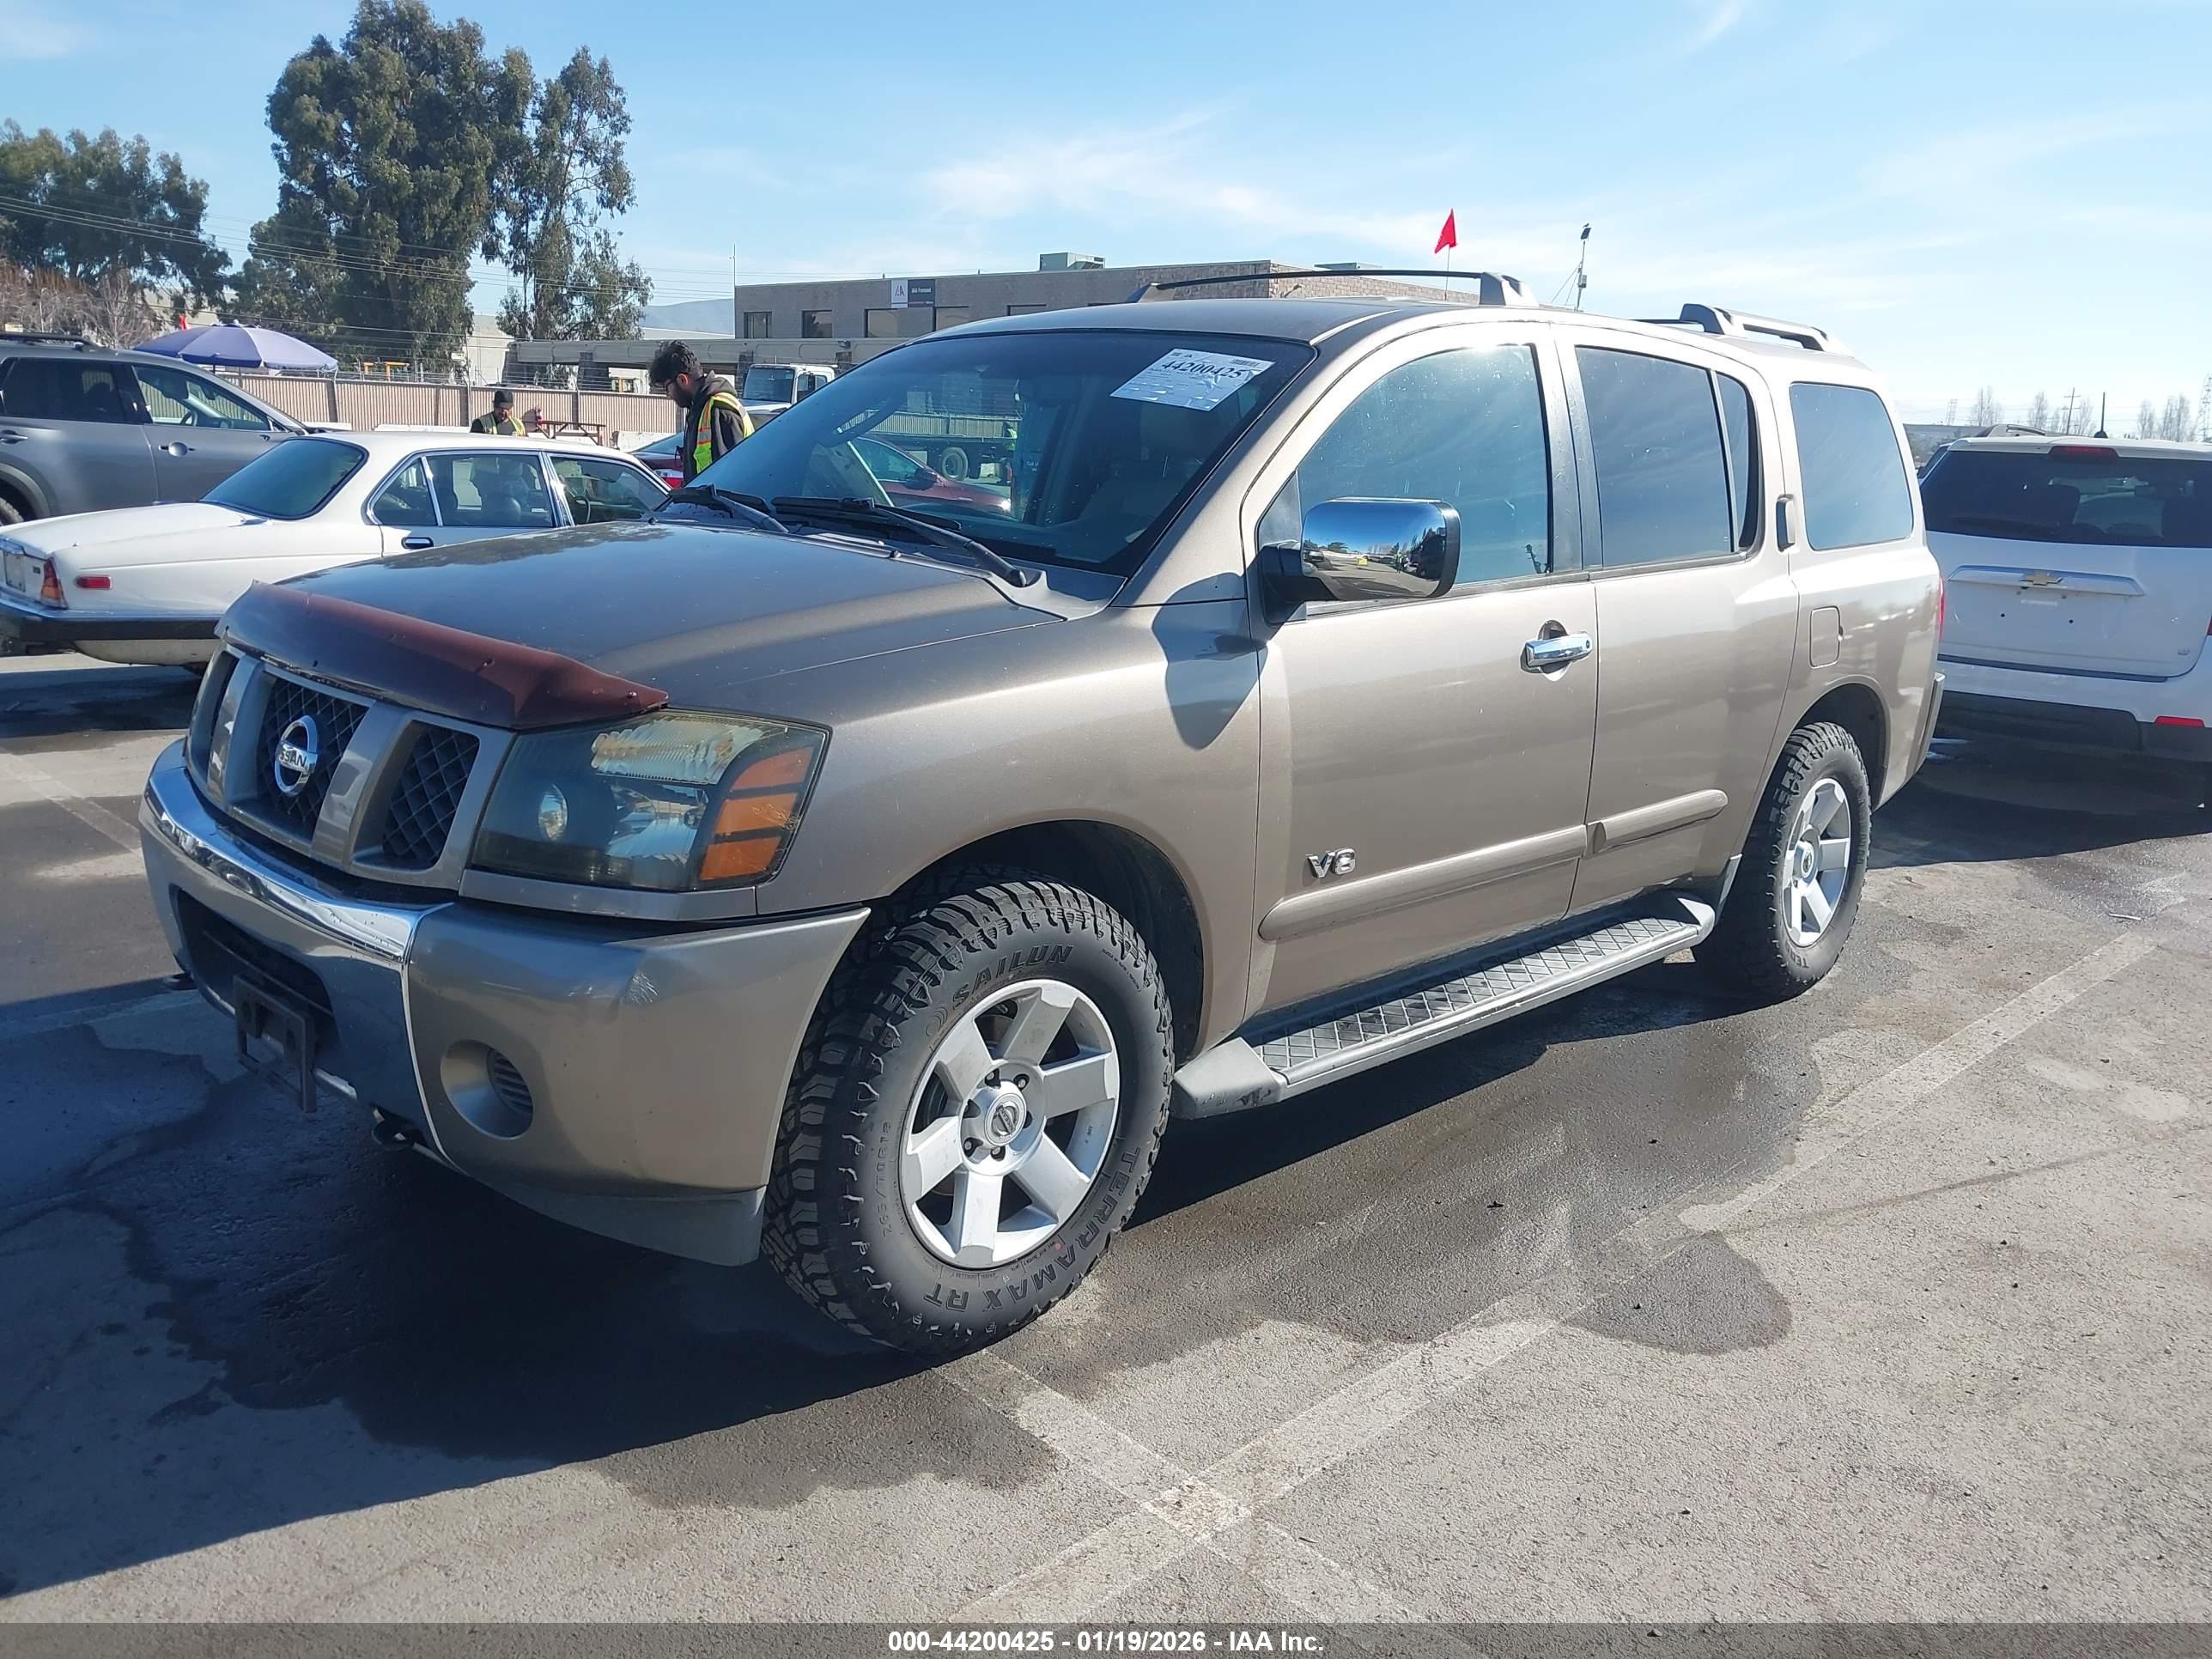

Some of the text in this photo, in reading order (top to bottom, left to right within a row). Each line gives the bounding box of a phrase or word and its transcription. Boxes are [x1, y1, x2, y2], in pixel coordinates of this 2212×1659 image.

[1162, 361, 1247, 379] 44200425
[1306, 848, 1356, 878] V6
[952, 943, 1074, 1011] SAILUN
[981, 1146, 1141, 1312] TERRAMAX
[923, 1283, 970, 1313] RT
